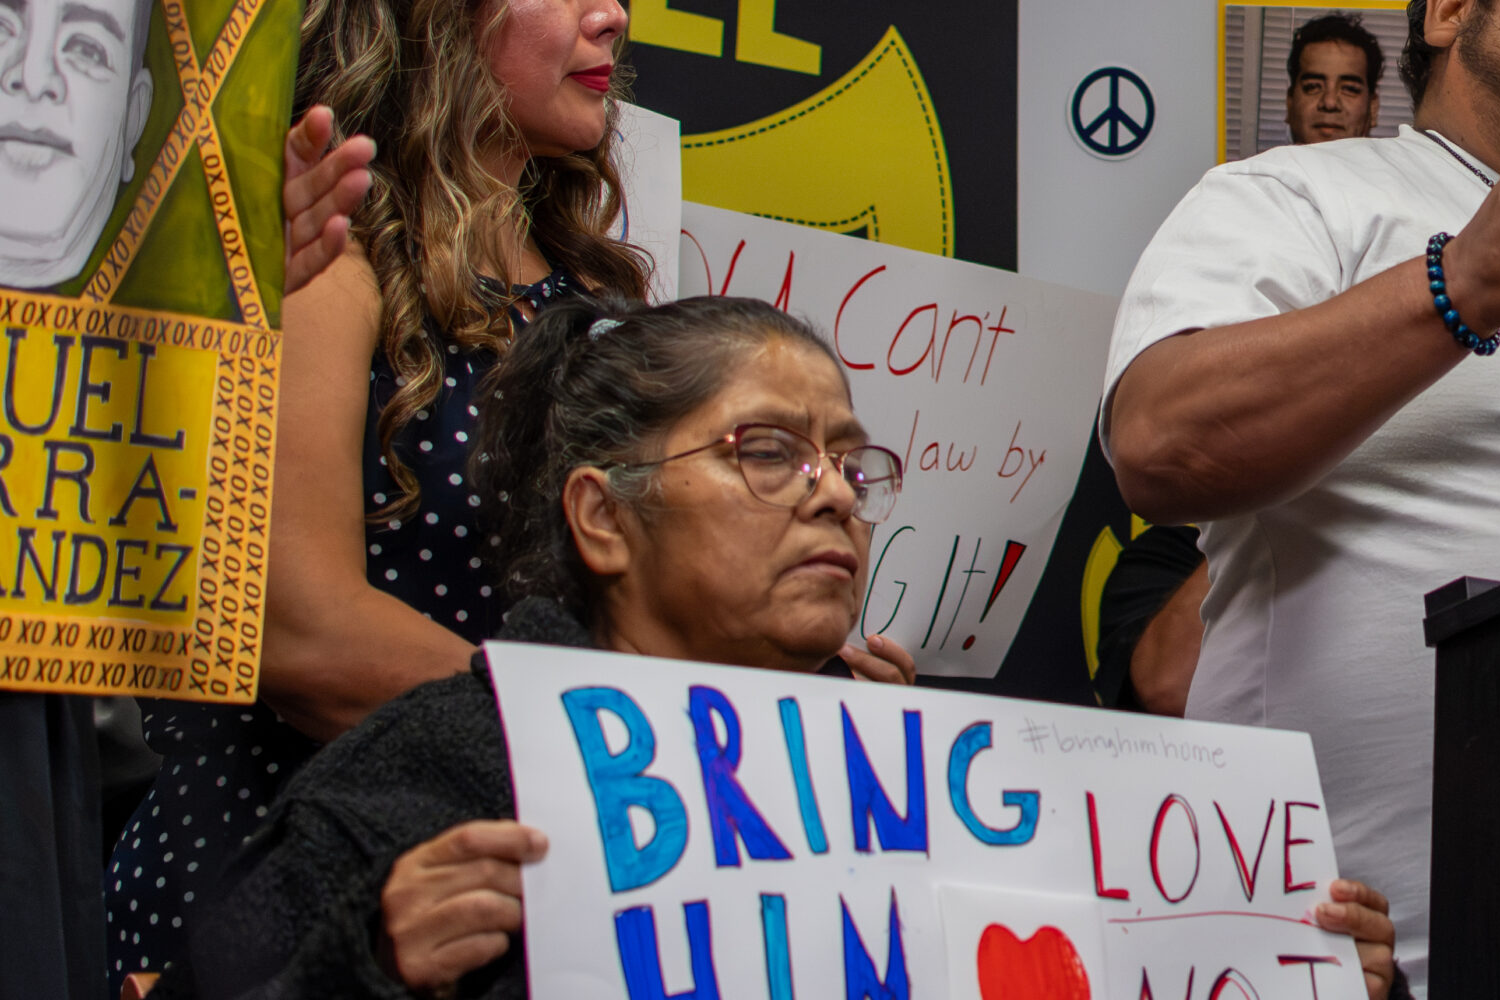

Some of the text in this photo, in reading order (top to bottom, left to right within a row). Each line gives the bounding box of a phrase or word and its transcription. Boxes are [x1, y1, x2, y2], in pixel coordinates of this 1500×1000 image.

[903, 410, 1047, 504] law by
[0, 526, 194, 612] NDEZ
[560, 685, 1041, 894] BRING
[1085, 790, 1321, 904] LOVE
